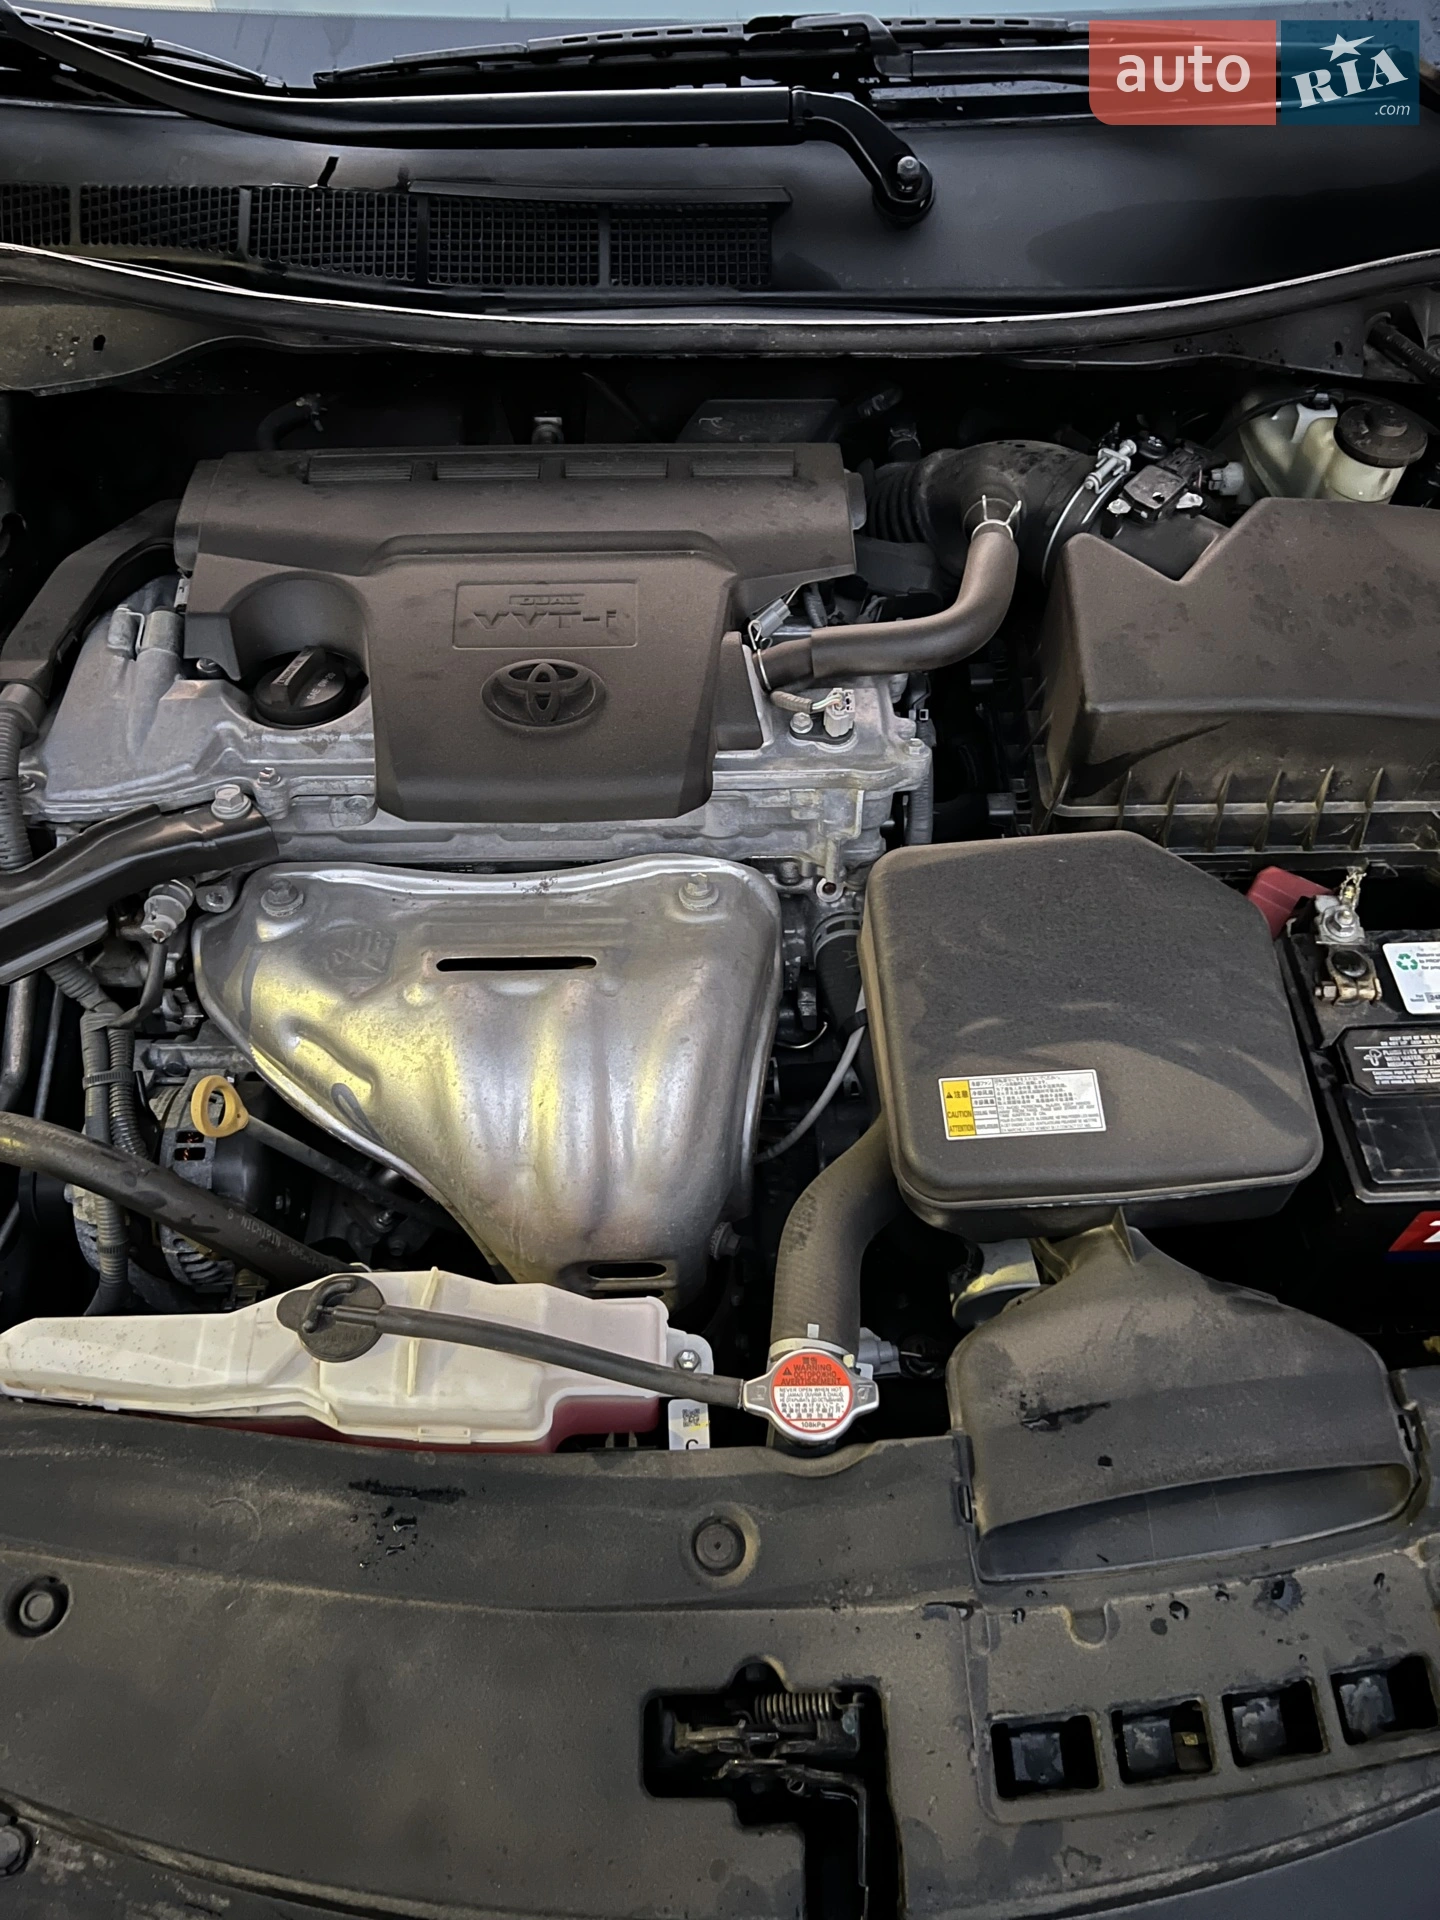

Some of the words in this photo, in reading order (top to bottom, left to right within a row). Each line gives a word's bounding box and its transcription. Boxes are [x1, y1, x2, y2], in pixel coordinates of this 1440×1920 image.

[947, 1110, 973, 1119] CAUTION
[949, 1124, 975, 1133] ATTENTION
[793, 1364, 832, 1372] WARNING
[780, 1378, 842, 1386] AVERTISSEMENT
